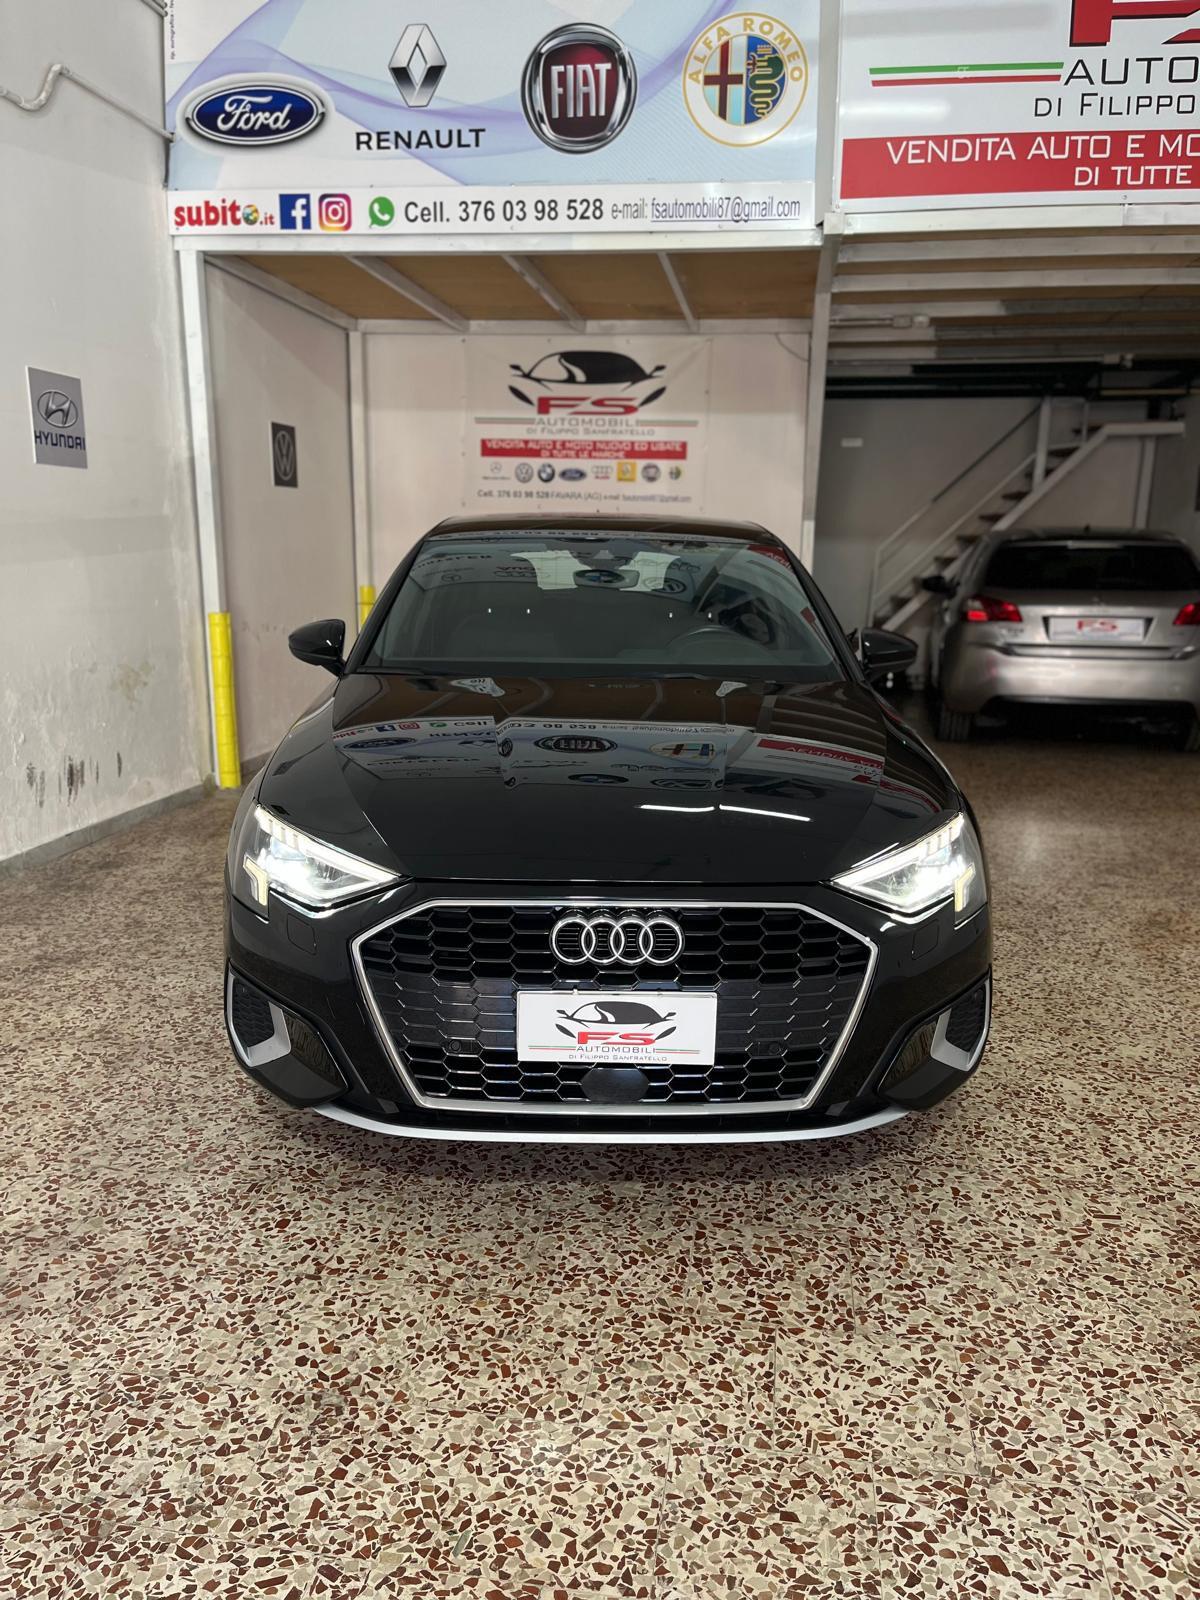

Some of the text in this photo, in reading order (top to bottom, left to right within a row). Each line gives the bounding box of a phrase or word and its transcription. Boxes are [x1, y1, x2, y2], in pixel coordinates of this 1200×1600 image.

[688, 18, 803, 84] ALFA ROMEO
[1064, 56, 1199, 86] AUTO
[551, 62, 612, 119] FIAT
[217, 95, 292, 131] Ford
[1034, 97, 1061, 117] DI
[355, 128, 486, 150] RENAULT
[887, 137, 1016, 165] VENDITA
[1027, 135, 1111, 160] AUTO
[1126, 134, 1146, 158] E
[1074, 165, 1192, 186] DI TUTTE
[405, 196, 800, 223] Cell. 376 03 98 528 e-mail: fsautomobili87@gmail.com
[537, 396, 639, 416] FS
[535, 417, 640, 427] AUTOMOBILI
[34, 430, 86, 451] HYUNDAI
[578, 1031, 656, 1045] FS
[577, 1045, 656, 1054] AUTOMOBILI
